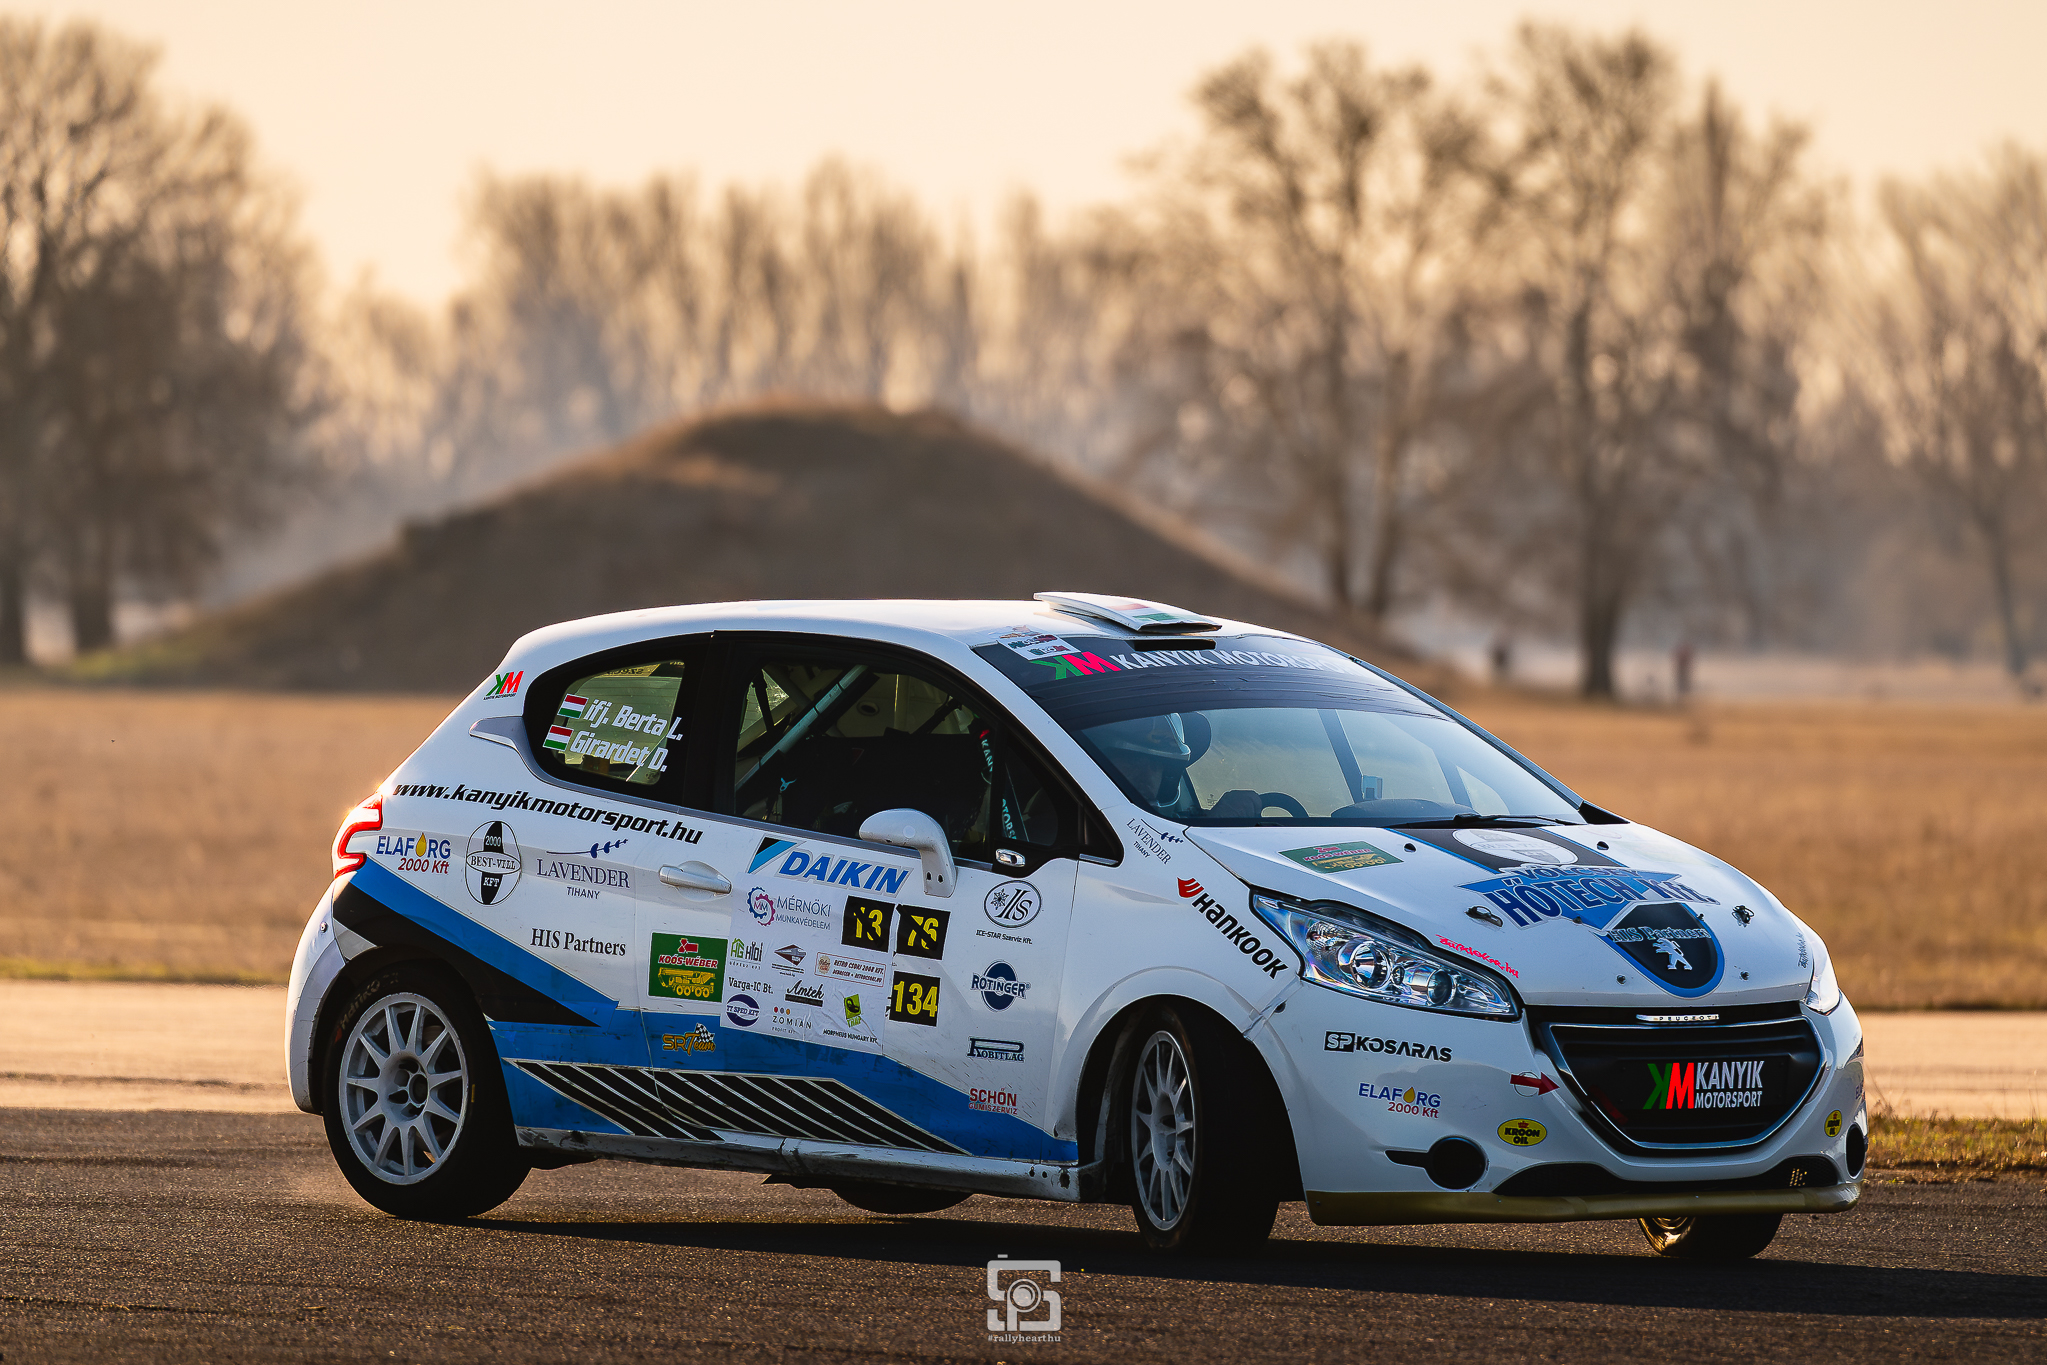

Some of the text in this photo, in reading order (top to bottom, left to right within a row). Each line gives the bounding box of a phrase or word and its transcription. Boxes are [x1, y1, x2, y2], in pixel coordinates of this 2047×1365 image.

[1110, 650, 1218, 670] KANYIK
[1210, 650, 1356, 677] MOTORSPO
[583, 699, 684, 741] ifj. Berta L.
[569, 730, 668, 773] Girardet D.
[393, 784, 703, 845] www.kanyikmotorsport.hu
[485, 835, 502, 847] 2000
[1126, 818, 1172, 865] LAVENDER
[397, 857, 450, 875] 2000 Kft
[470, 856, 516, 870] BEST-VILL
[778, 850, 909, 894] DAIKIN
[483, 877, 500, 888] KFT
[537, 858, 630, 889] LAVENDER
[567, 886, 600, 900] TIHANY
[775, 913, 831, 930] MUNKAVÉDELEM
[529, 928, 627, 957] HIS Partners
[1608, 926, 1712, 943] HIS Partners
[658, 954, 719, 969] KOÓS-WÉBER
[728, 976, 774, 994] Varga-IC Bt.
[786, 980, 824, 999] Amtek
[971, 974, 1026, 998] ROTINGER
[893, 980, 938, 1018] 134
[772, 1015, 812, 1030] ZOMIAN
[822, 1029, 847, 1039] MORPHEUS
[847, 1032, 869, 1042] HUNGARY
[1326, 1033, 1453, 1062] SP KOSARAS
[1695, 1061, 1765, 1090] KANYIK
[969, 1087, 1017, 1107] SCHÖN
[1694, 1090, 1763, 1109] MOTORSPORT
[1387, 1101, 1440, 1119] 2000 Kft
[1504, 1127, 1541, 1138] KROON
[1513, 1136, 1529, 1145] OIL
